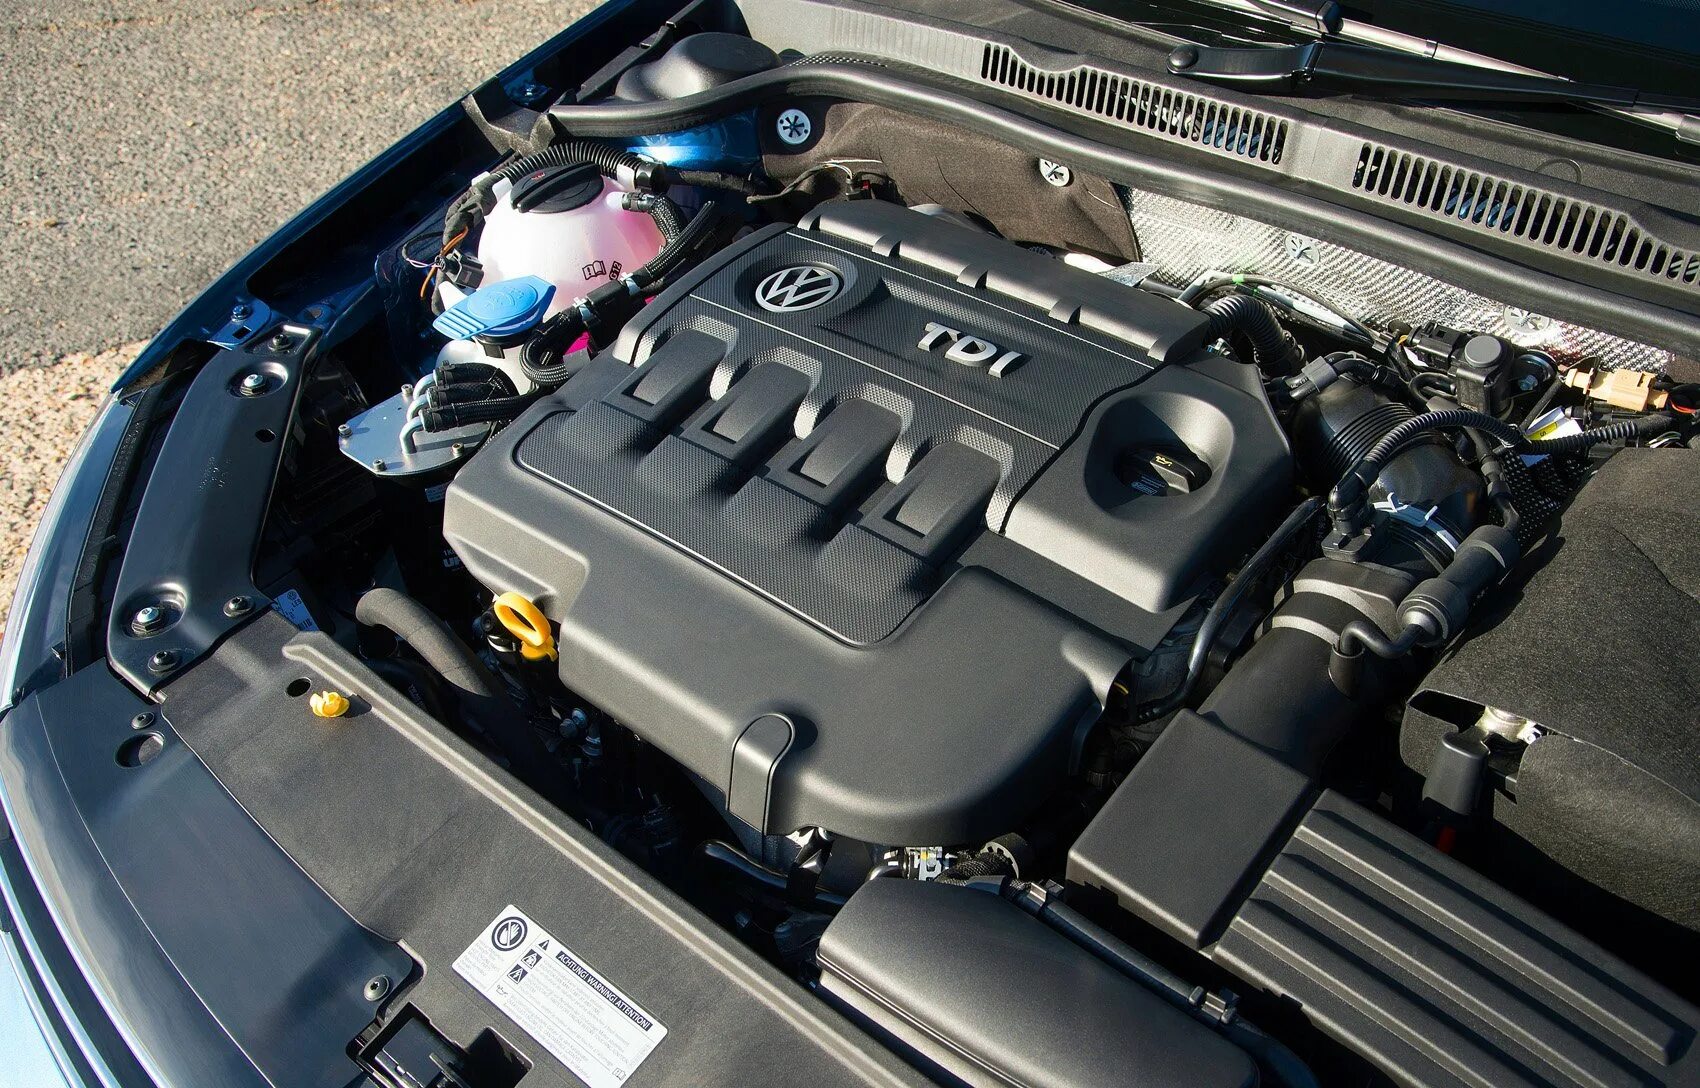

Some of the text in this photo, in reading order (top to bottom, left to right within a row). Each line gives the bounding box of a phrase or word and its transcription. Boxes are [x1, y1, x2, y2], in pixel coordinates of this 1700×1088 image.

[609, 262, 621, 280] G12
[917, 321, 1022, 378] TDI
[557, 952, 650, 1029] ACHTUNG! WARNING! ATTENTION!
